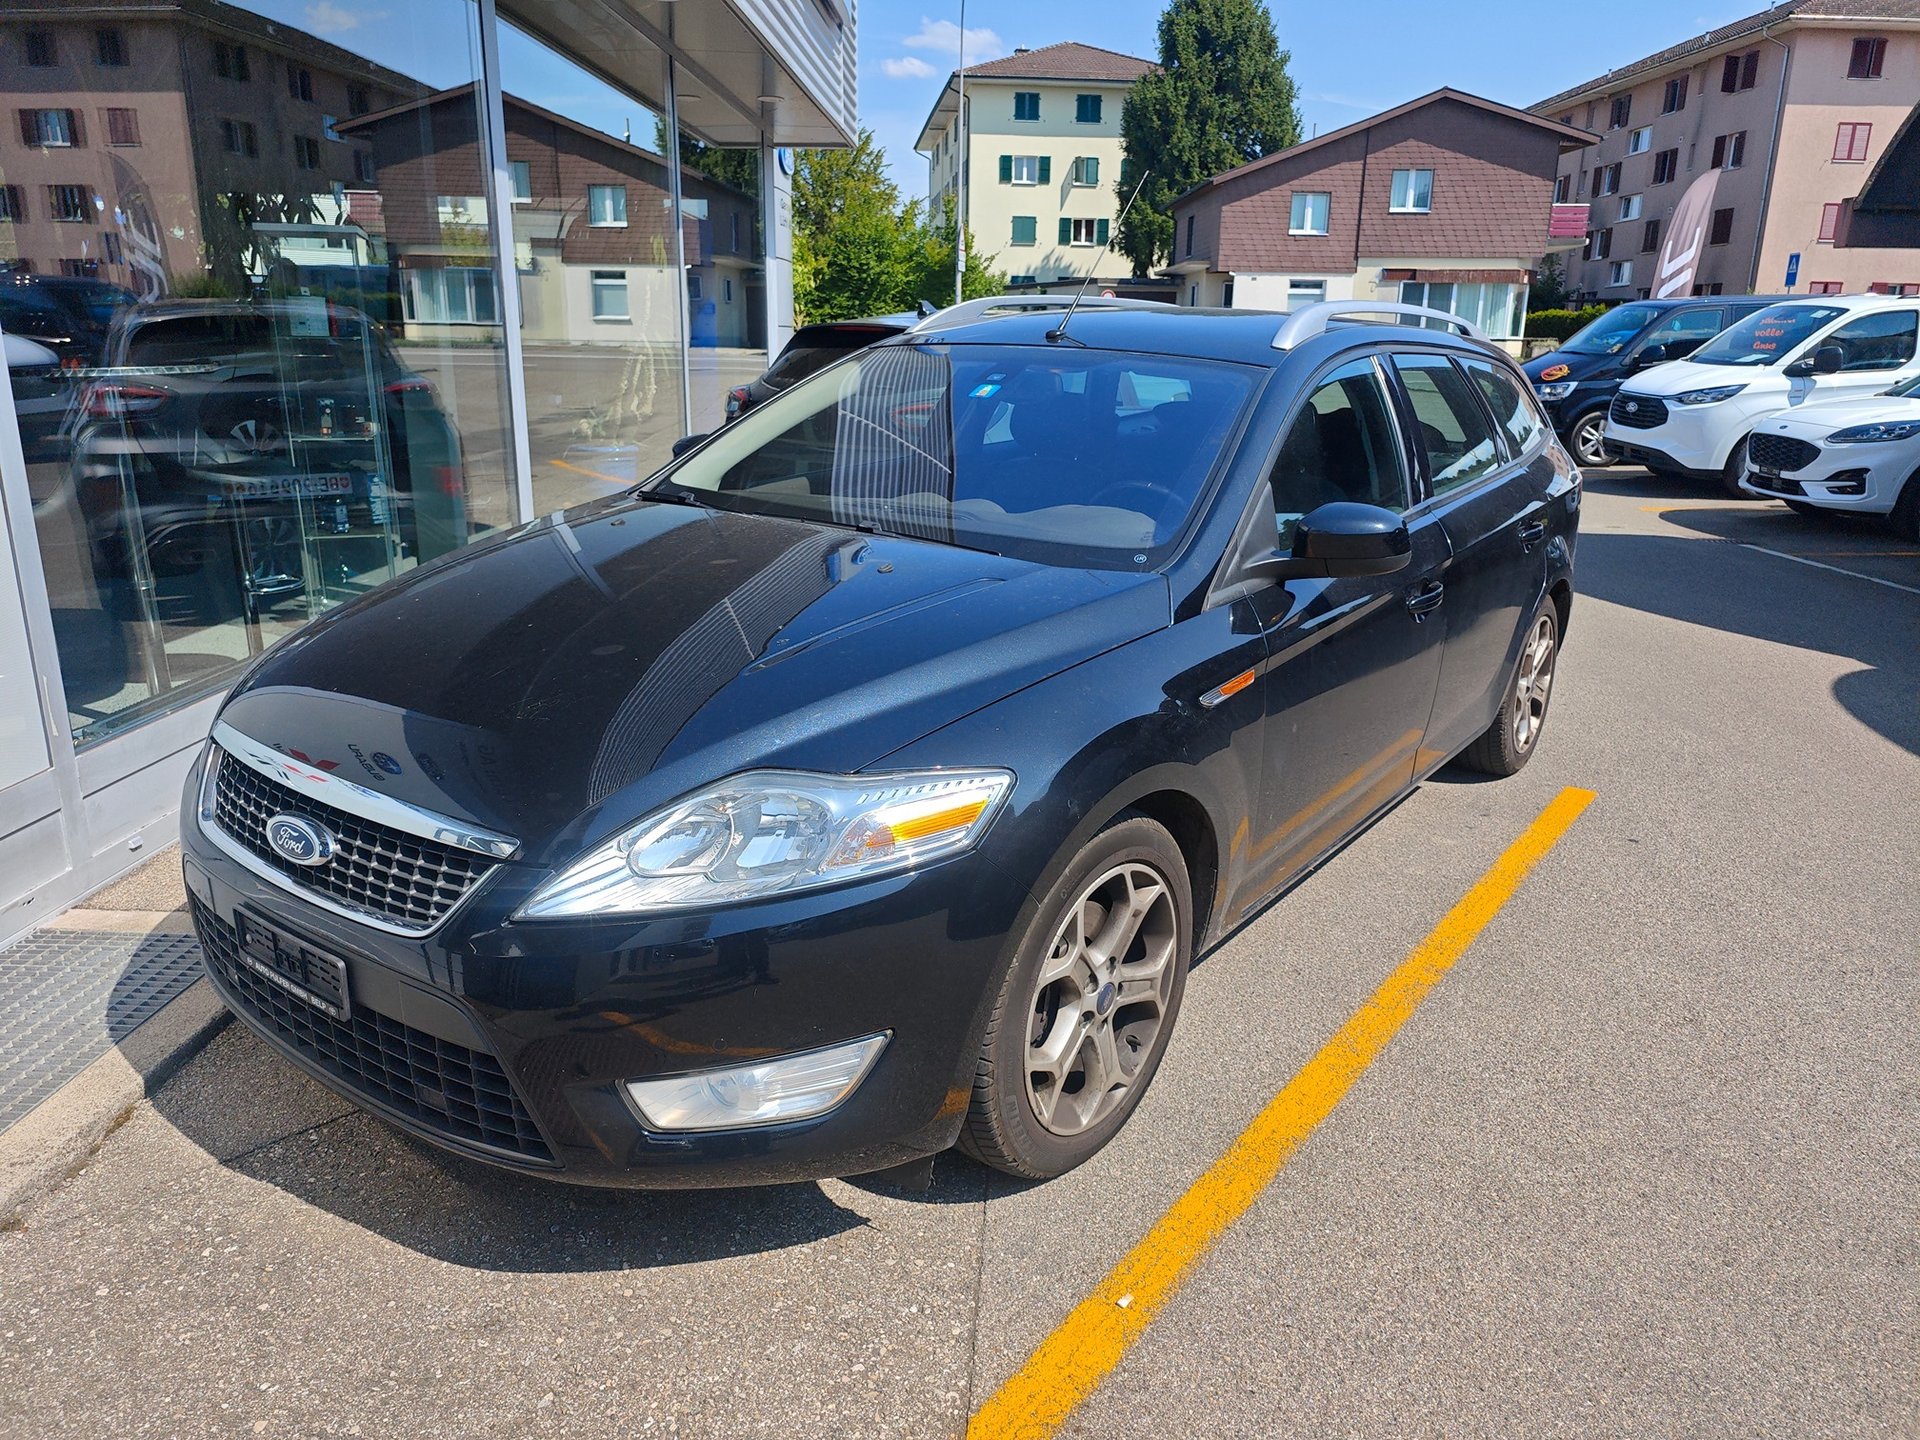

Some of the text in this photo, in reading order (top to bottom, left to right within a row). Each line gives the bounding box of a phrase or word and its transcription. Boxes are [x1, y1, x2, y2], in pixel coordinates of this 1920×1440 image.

[277, 826, 306, 854] Ford
[255, 962, 269, 976] AUTO
[311, 996, 327, 1009] BELP
